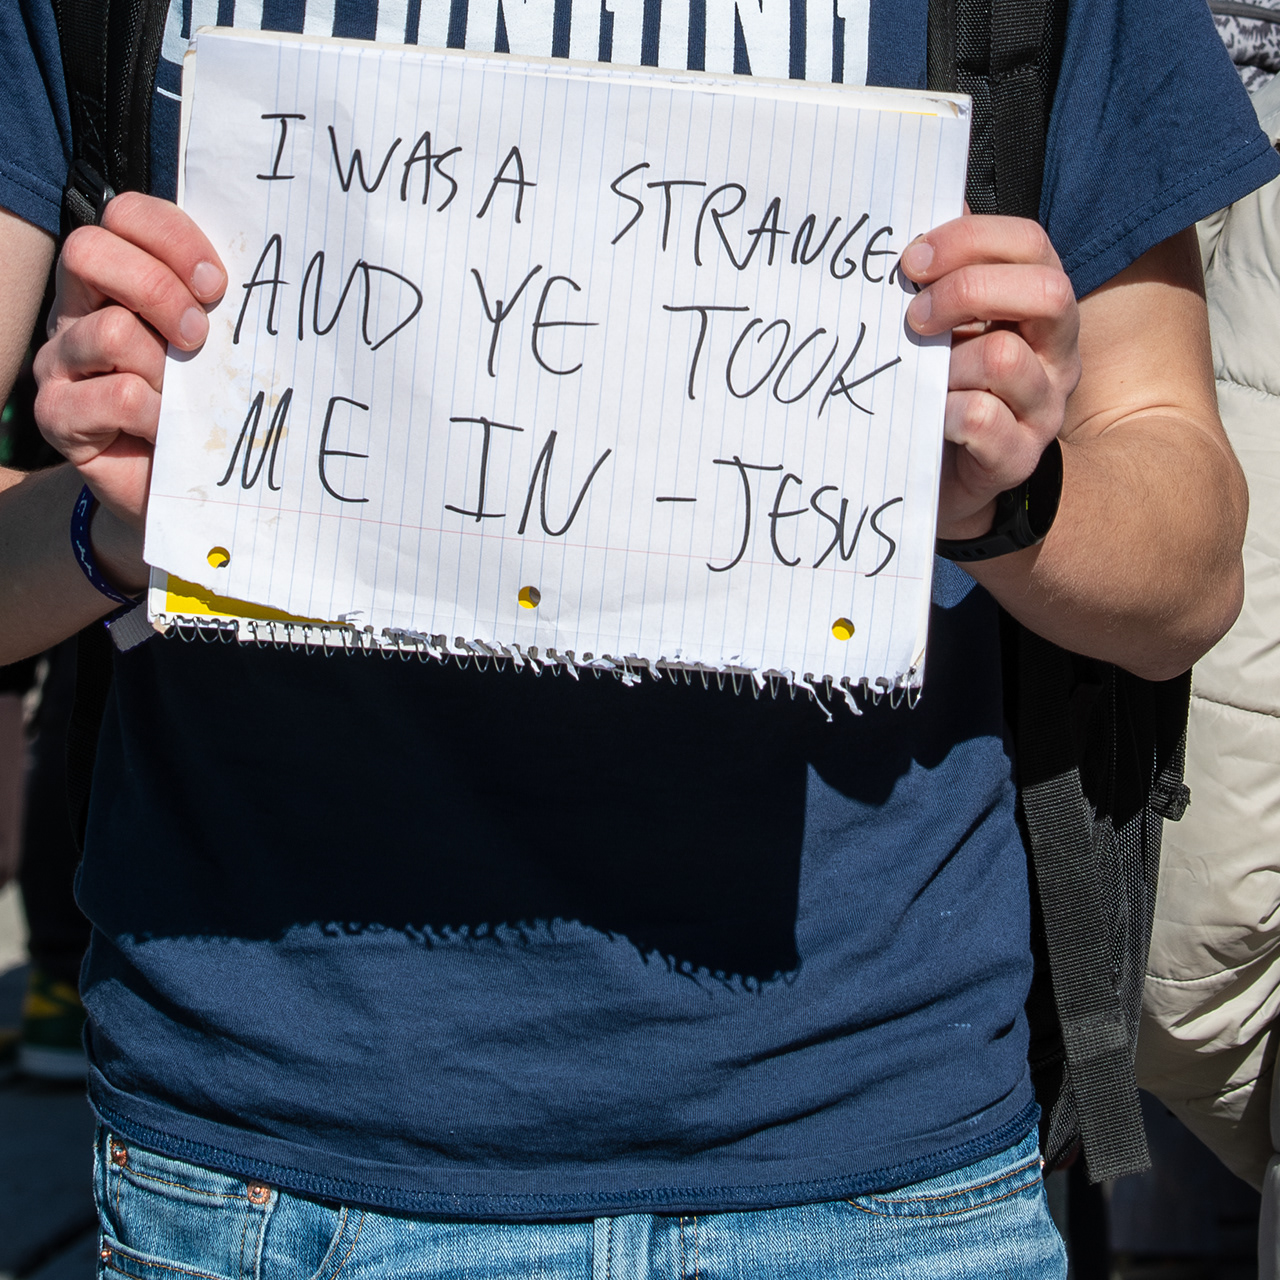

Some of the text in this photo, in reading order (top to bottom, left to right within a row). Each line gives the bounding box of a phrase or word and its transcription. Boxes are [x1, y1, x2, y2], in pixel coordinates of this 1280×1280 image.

[257, 113, 926, 294] I WAS A STRANGE
[232, 233, 902, 417] AND YE TOOK
[216, 387, 370, 503] ME
[444, 416, 612, 538] IN
